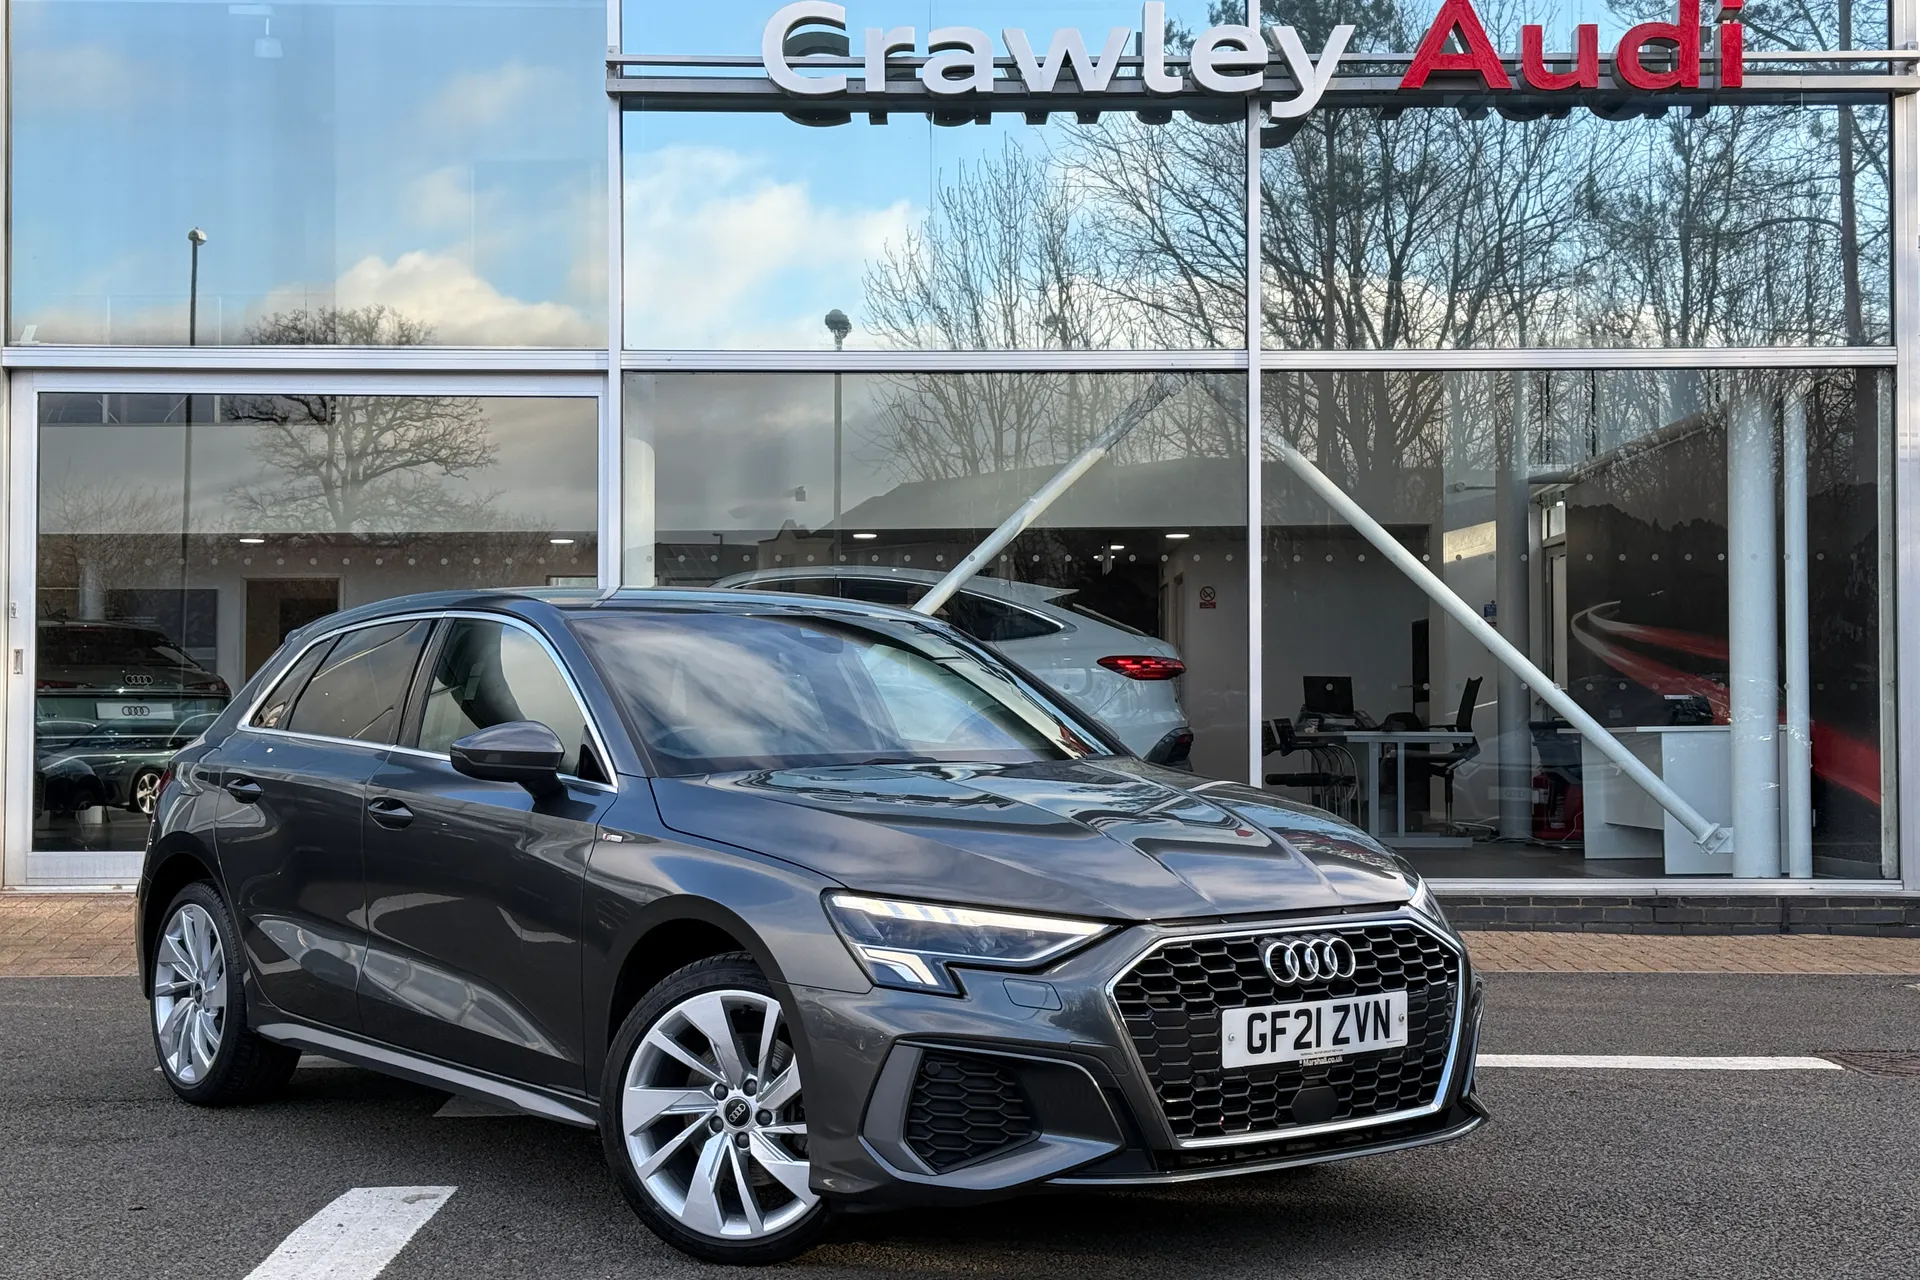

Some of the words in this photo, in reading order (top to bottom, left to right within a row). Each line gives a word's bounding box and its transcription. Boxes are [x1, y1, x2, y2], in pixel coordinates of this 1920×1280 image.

[761, 0, 1355, 119] Crawley
[1399, 0, 1743, 91] Audi
[1247, 1007, 1322, 1055] GF21
[1332, 999, 1391, 1046] ZVN
